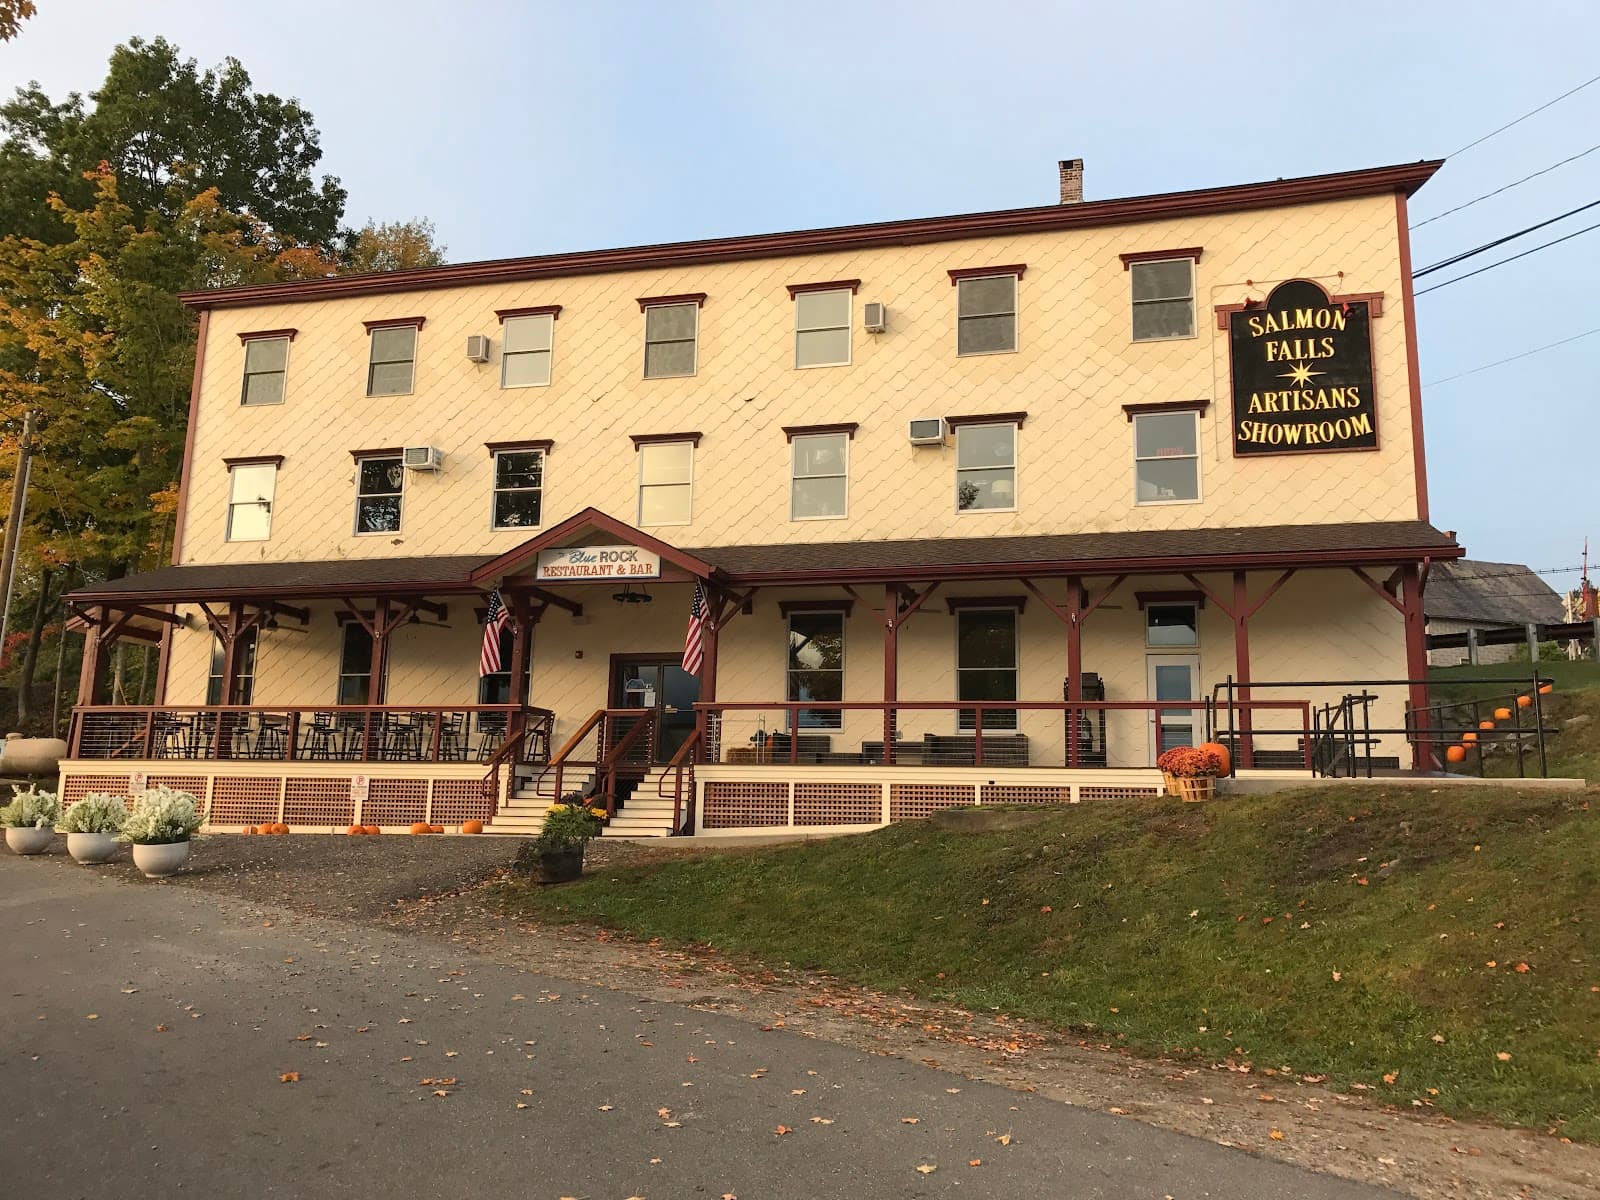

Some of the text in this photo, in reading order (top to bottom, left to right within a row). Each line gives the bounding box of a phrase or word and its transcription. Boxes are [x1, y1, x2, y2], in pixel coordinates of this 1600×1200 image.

[1249, 308, 1346, 337] SALMON
[1266, 337, 1335, 362] FALLS
[1248, 387, 1360, 413] ARTISANS
[1238, 413, 1373, 445] SHOWROOM
[569, 550, 597, 563] Blue
[600, 550, 638, 562] ROCK
[543, 563, 653, 577] RESTAURANT & BAR
